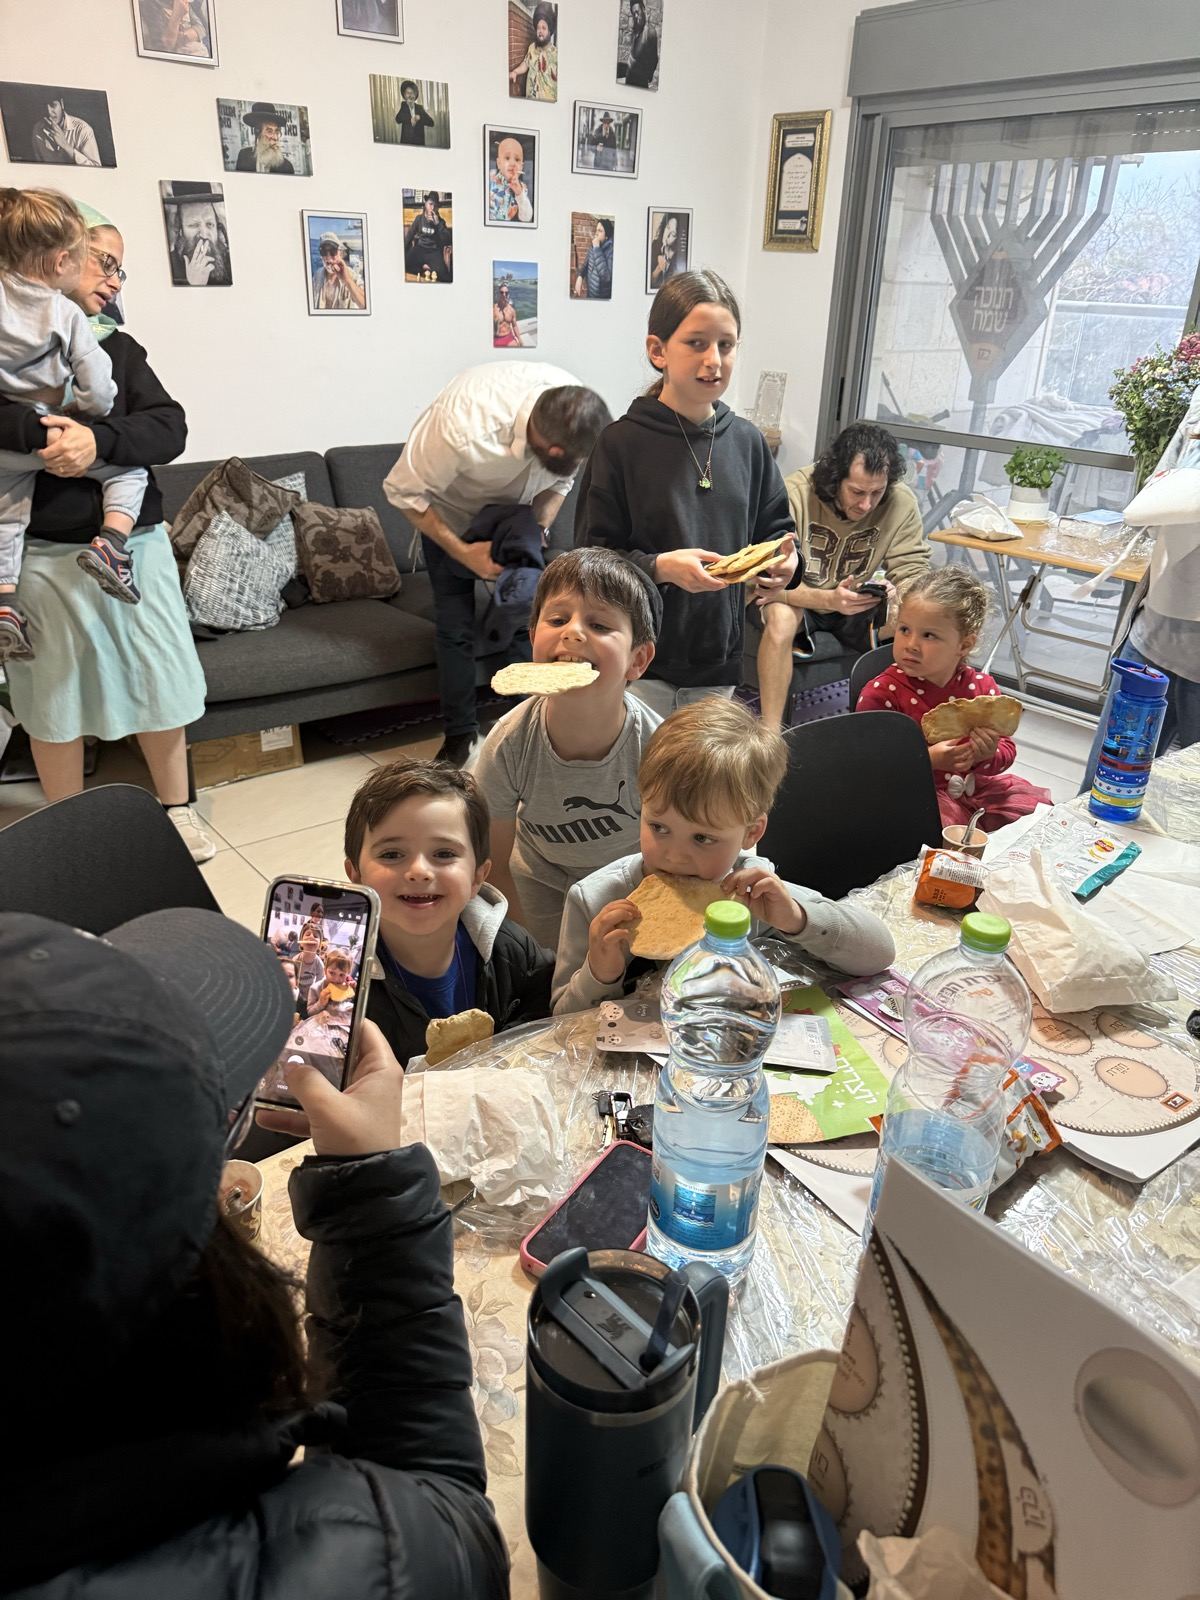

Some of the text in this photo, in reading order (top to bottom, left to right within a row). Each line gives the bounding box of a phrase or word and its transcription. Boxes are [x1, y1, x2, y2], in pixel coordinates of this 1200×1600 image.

[974, 286, 1015, 309] חנוכה
[971, 309, 1009, 333] שמח
[523, 815, 624, 844] PUMA
